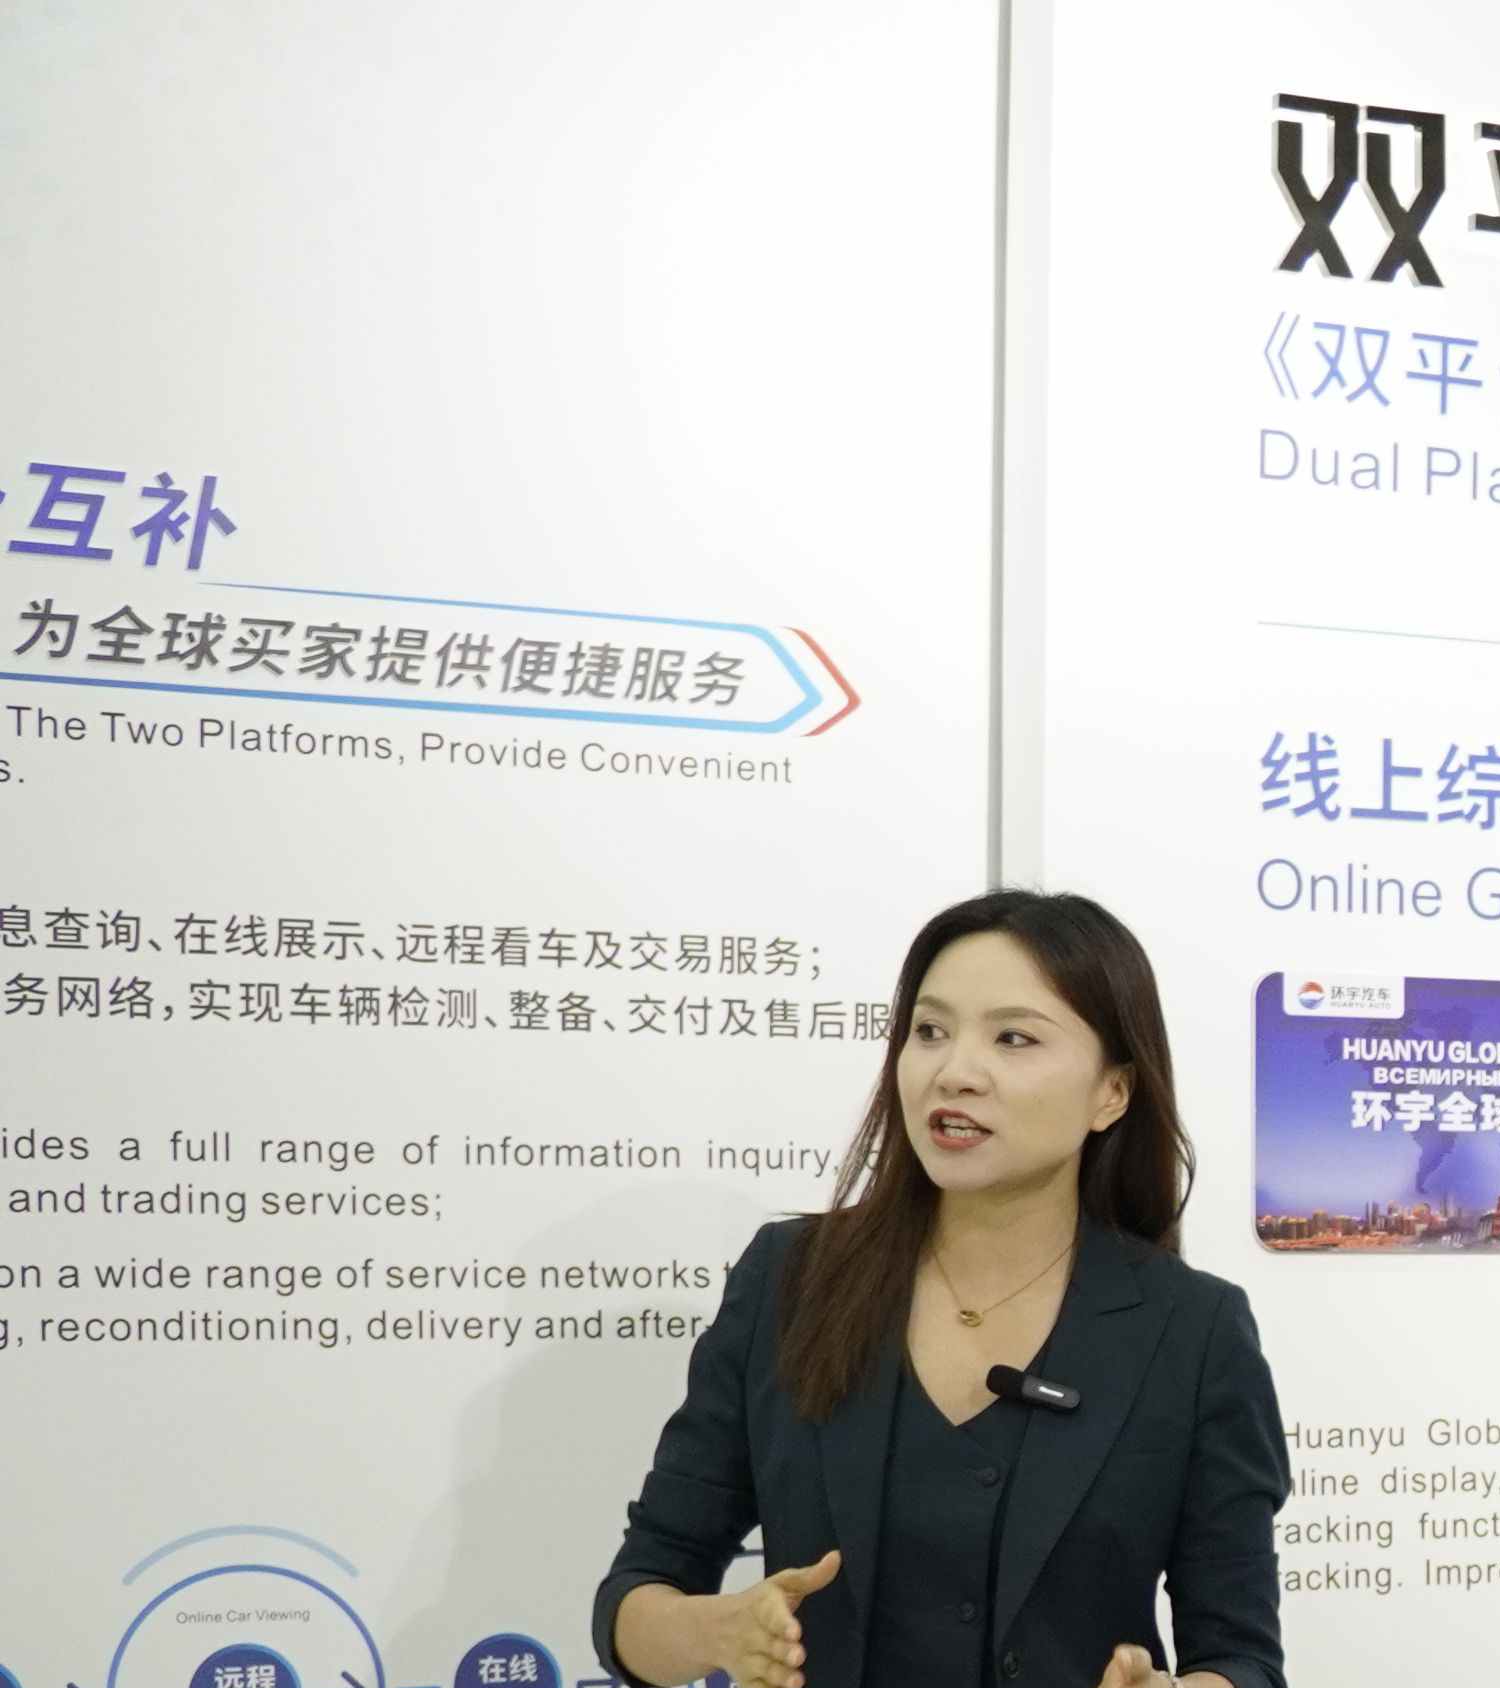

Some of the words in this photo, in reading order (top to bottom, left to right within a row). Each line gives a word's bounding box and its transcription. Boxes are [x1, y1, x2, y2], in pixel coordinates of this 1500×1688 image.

[1258, 427, 1400, 494] Dual
[0, 461, 239, 573] 互补
[11, 596, 746, 707] 为全球买家提供便捷服务
[4, 703, 88, 742] The
[98, 710, 185, 748] Two
[198, 716, 406, 767] Platforms,
[419, 730, 568, 771] Provide
[579, 741, 793, 785] Convenient
[1255, 856, 1444, 919] Online
[1342, 1037, 1445, 1064] HUANYU
[118, 1136, 142, 1163] a
[168, 1128, 231, 1164] full
[259, 1138, 376, 1174] range
[400, 1133, 442, 1167] of
[464, 1134, 682, 1170] information
[7, 1181, 87, 1215] and
[99, 1182, 248, 1225] trading
[260, 1184, 442, 1222] services;
[0, 1263, 43, 1290] on
[56, 1263, 81, 1290] a
[93, 1256, 192, 1290] wide
[205, 1264, 324, 1298] range
[335, 1256, 376, 1290] of
[384, 1257, 528, 1290] service
[539, 1258, 712, 1290] networks
[39, 1308, 353, 1350] reconditioning,
[365, 1308, 524, 1349] delivery
[533, 1308, 604, 1341] and
[175, 1610, 223, 1625] Online
[225, 1609, 252, 1624] Car
[255, 1608, 311, 1624] Viewing
[478, 1653, 539, 1684] 在线
